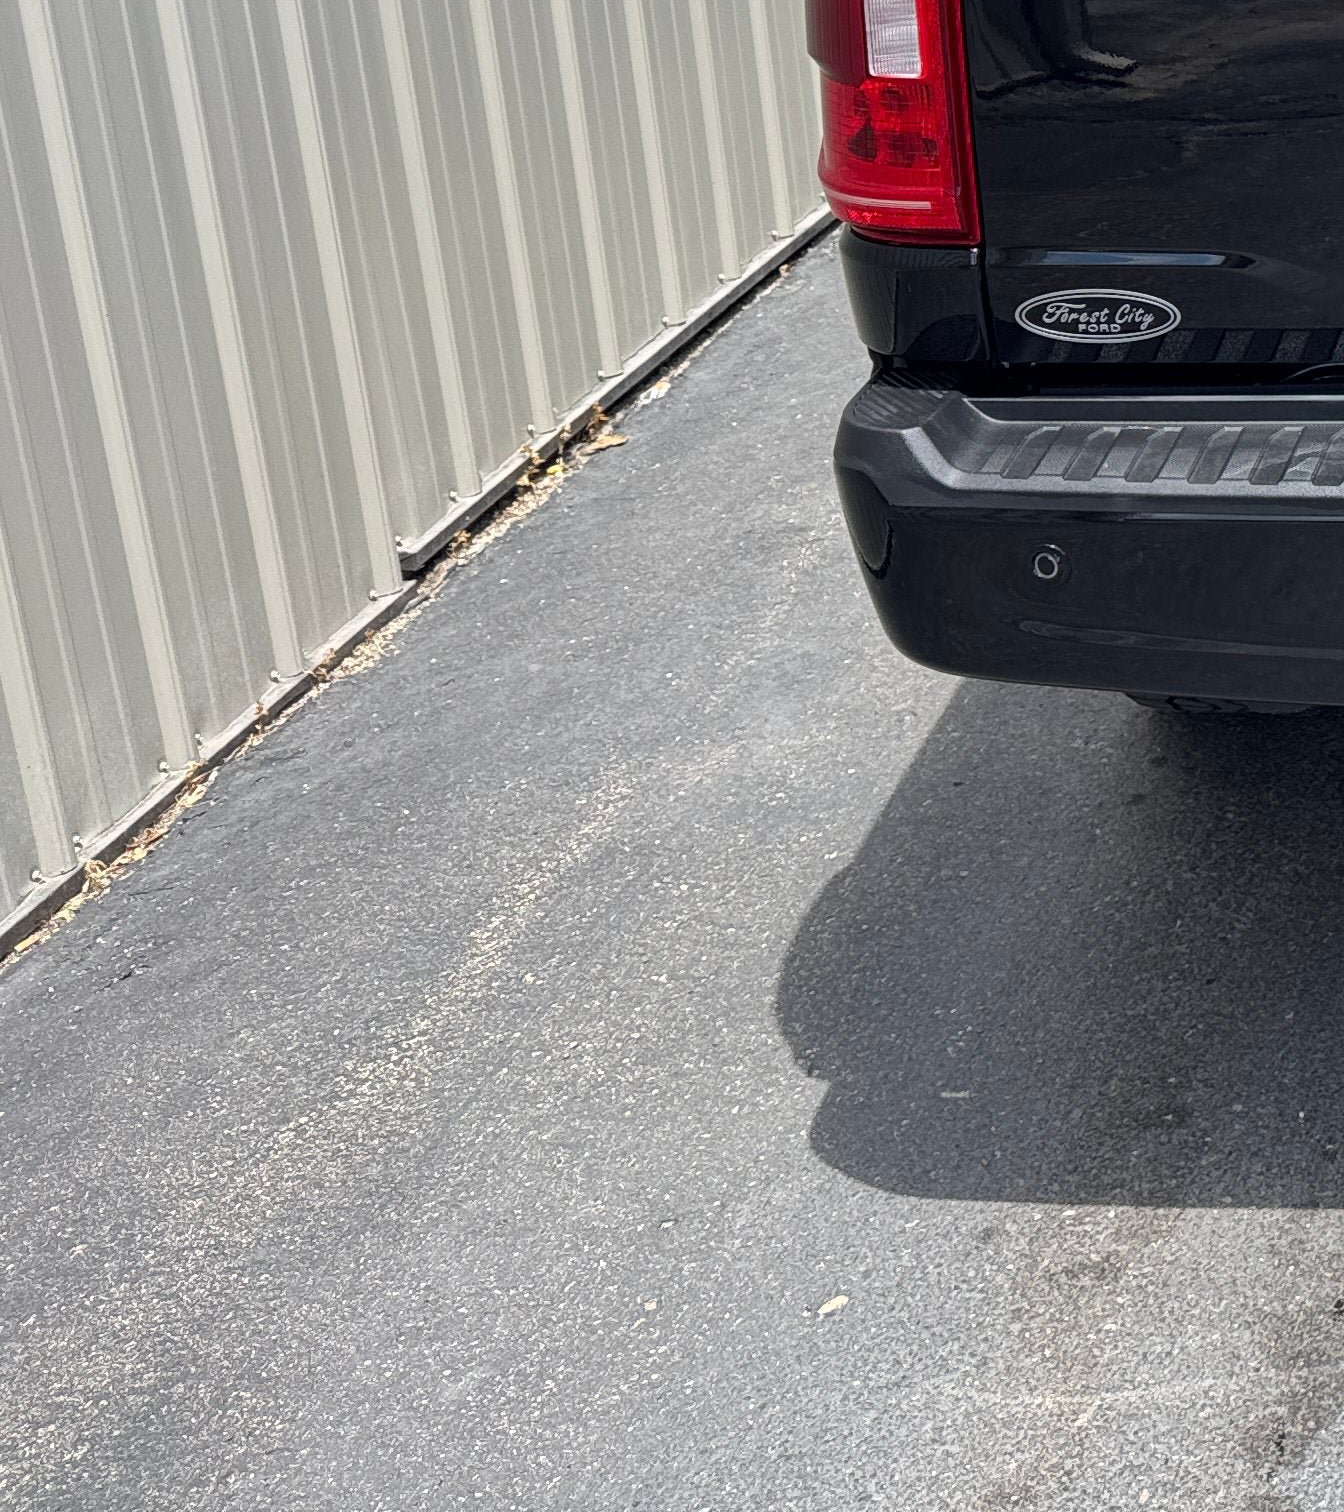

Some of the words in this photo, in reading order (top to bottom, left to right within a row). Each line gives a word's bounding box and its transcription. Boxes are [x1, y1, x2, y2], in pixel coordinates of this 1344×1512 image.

[1041, 302, 1110, 324] Forest
[1114, 303, 1155, 331] City
[1078, 323, 1121, 333] FORD
